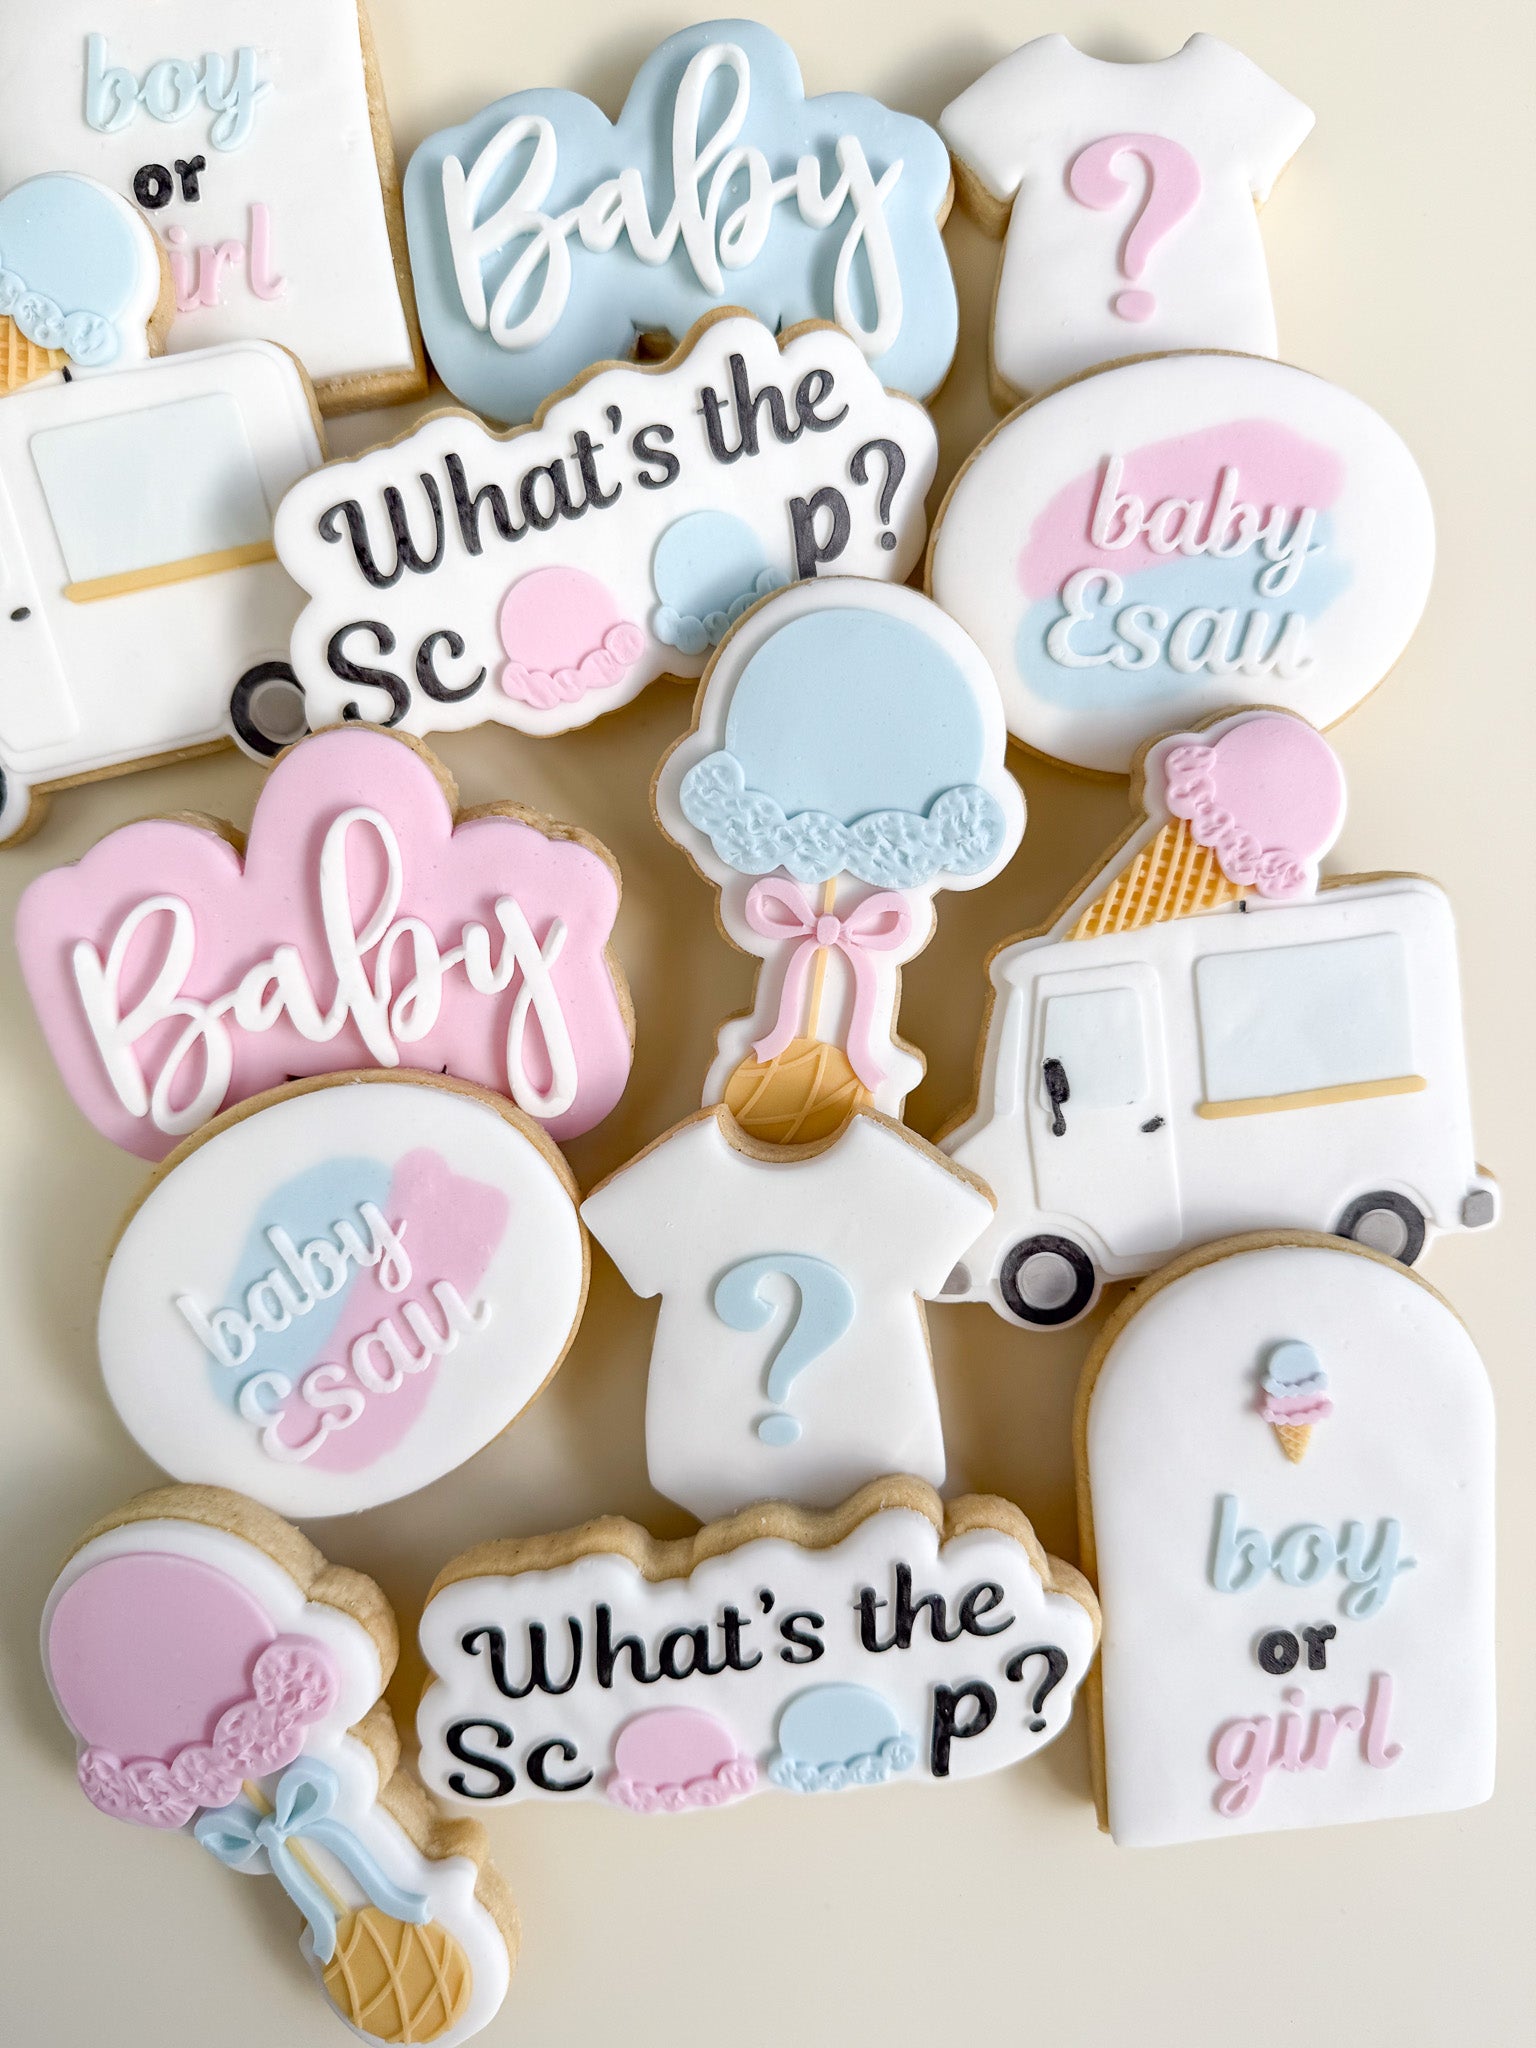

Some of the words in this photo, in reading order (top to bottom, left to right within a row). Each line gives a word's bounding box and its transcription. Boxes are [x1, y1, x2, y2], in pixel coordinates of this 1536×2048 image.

[85, 32, 275, 153] boy
[132, 154, 207, 210] or
[441, 42, 905, 360] Baby
[1069, 132, 1202, 323] ?
[167, 202, 287, 313] irl
[318, 404, 682, 590] What's
[696, 353, 850, 465] the
[1090, 455, 1327, 598] baby
[1046, 567, 1318, 679] Esau
[72, 805, 578, 1136] Baby
[175, 1200, 413, 1367] baby
[713, 1253, 857, 1447] ?
[238, 1280, 493, 1463] Esau
[1212, 1493, 1418, 1621] boy
[460, 1588, 826, 1699] What's
[852, 1563, 1017, 1653] the
[1257, 1623, 1337, 1675] or
[1214, 1671, 1404, 1819] girl
